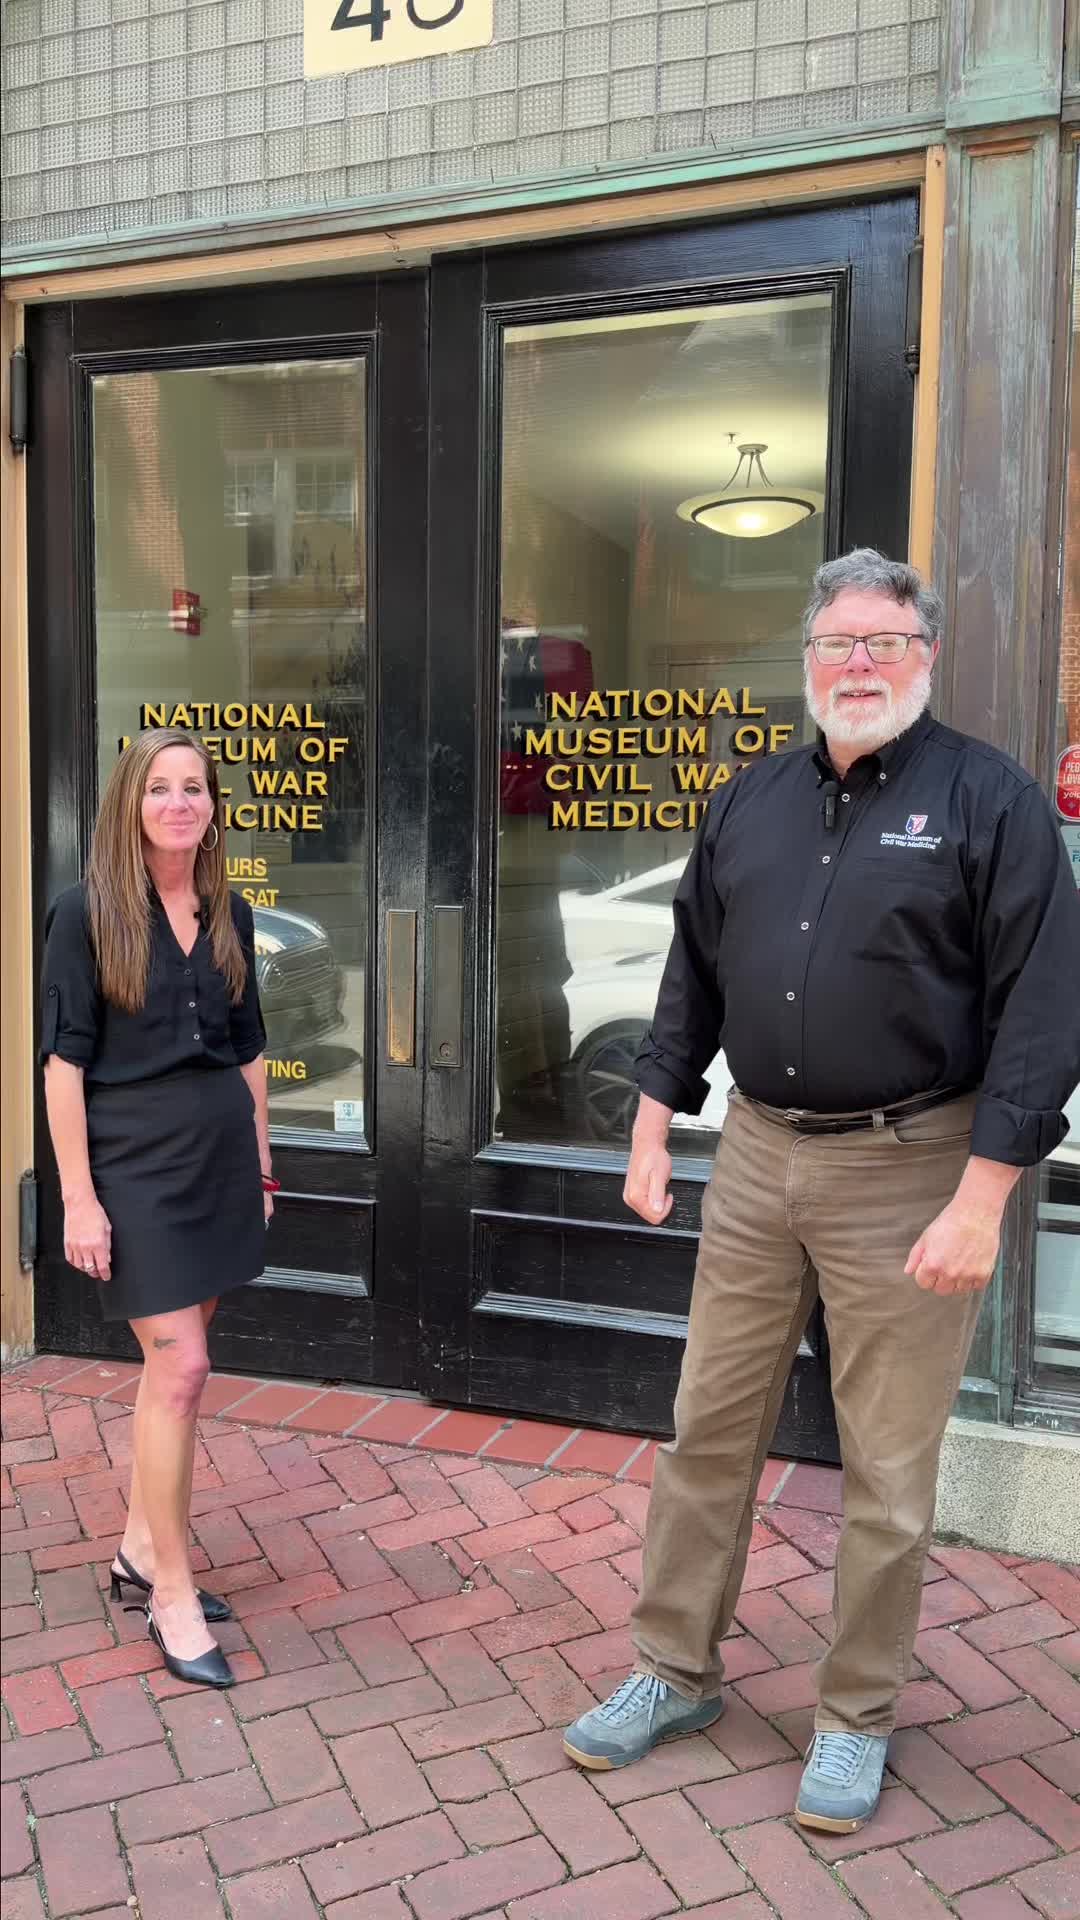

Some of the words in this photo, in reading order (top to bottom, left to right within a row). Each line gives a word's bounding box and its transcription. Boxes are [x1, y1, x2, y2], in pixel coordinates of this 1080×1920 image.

[141, 703, 326, 730] NATIONAL
[551, 687, 767, 720] NATIONAL
[298, 736, 349, 765] OF
[524, 726, 707, 757] MUSEUM
[733, 724, 794, 755] OF
[250, 770, 329, 797] WAR
[544, 763, 652, 793] CIVIL
[672, 761, 752, 793] WA
[224, 803, 324, 832] ICINE
[550, 800, 708, 830] MEDICI
[880, 838, 895, 846] Civil
[895, 839, 908, 848] War
[907, 841, 937, 850] Medicine
[881, 832, 907, 841] National
[907, 834, 934, 843] Museum
[933, 836, 942, 844] of
[225, 857, 268, 878] URS
[241, 888, 280, 907] SAT
